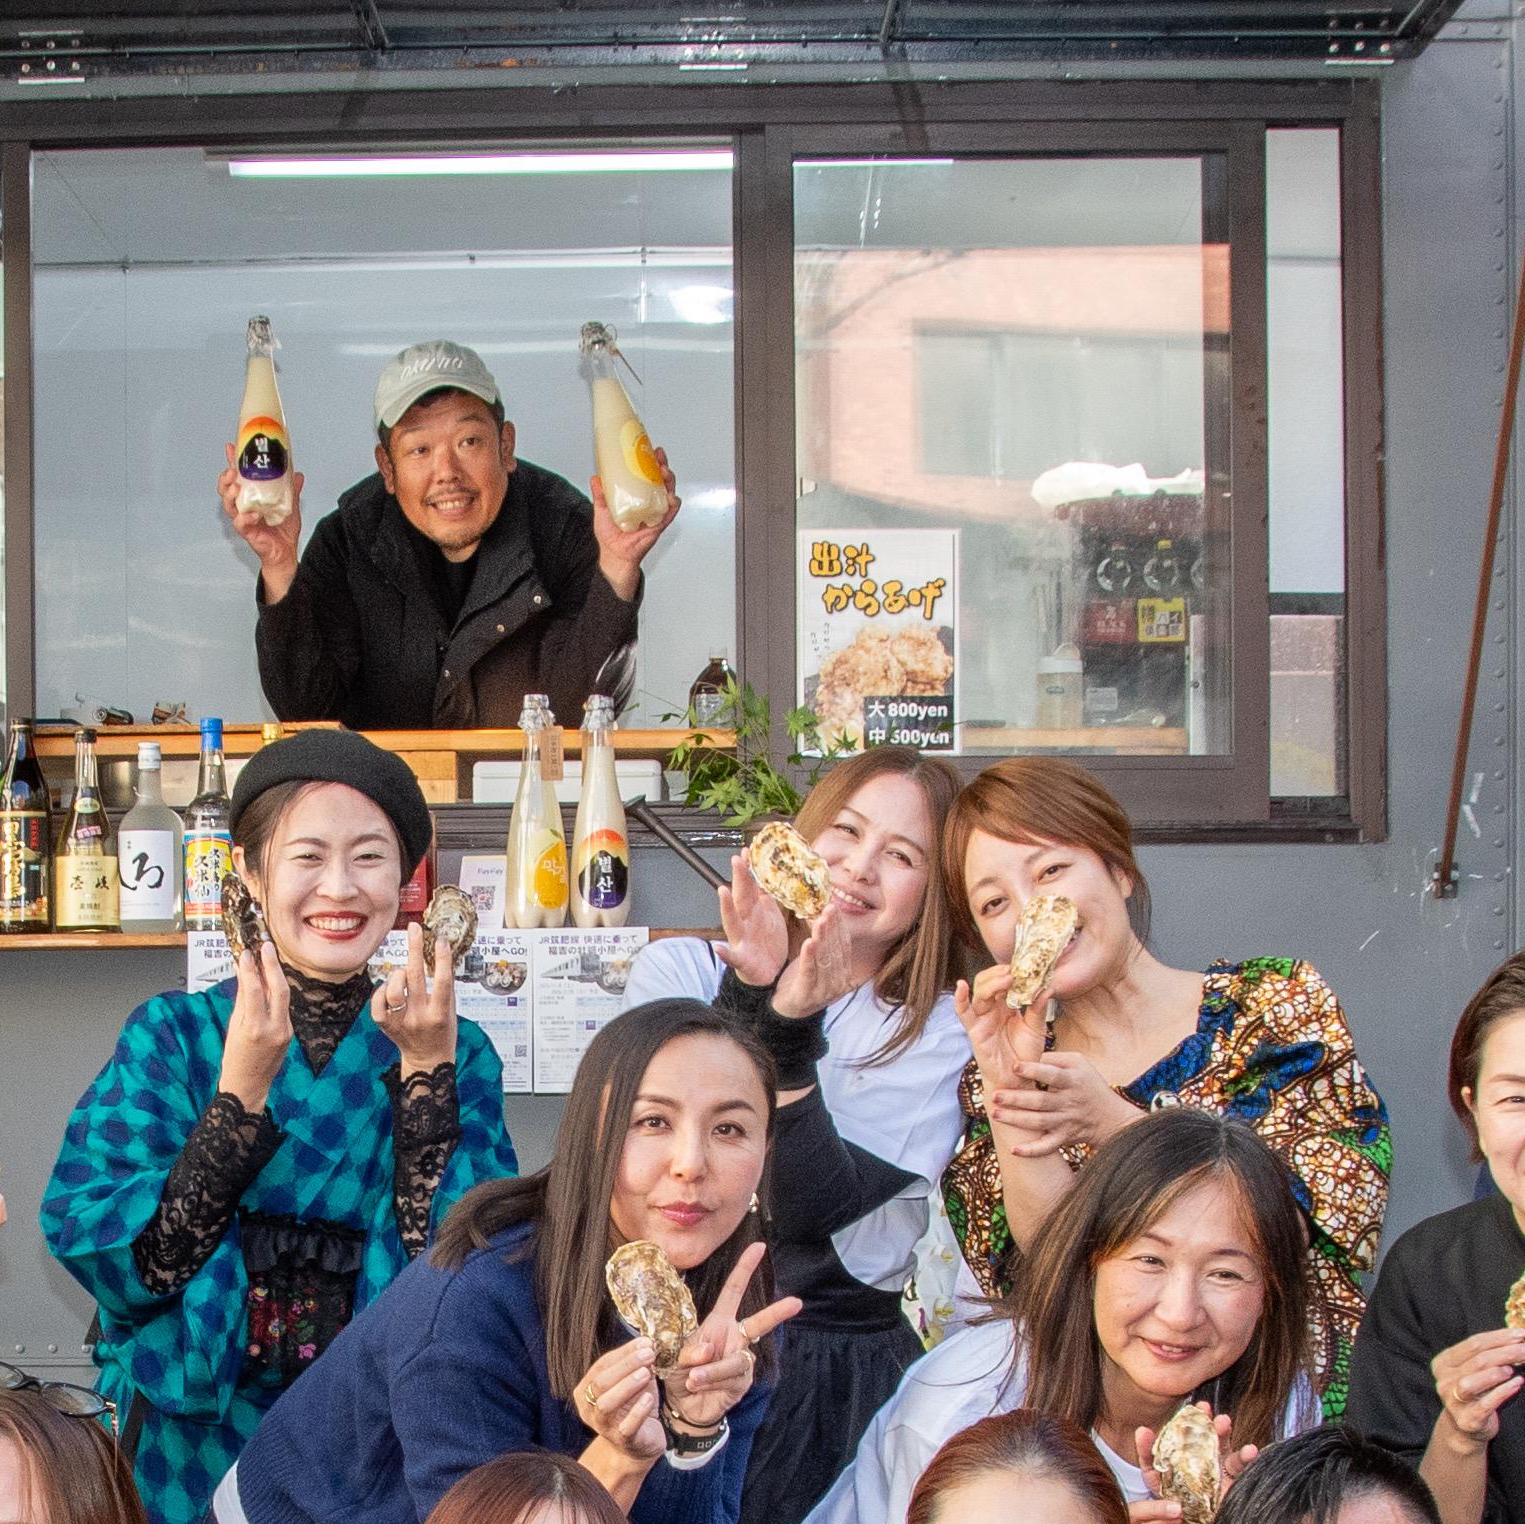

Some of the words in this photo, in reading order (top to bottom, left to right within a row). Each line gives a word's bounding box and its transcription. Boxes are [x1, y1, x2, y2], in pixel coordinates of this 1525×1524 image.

[809, 540, 876, 578] 出汁
[822, 578, 947, 620] からあげ
[868, 700, 885, 718] 大
[887, 702, 948, 721] 800yen
[869, 727, 886, 745] 中
[476, 935, 522, 946] 速に乗って
